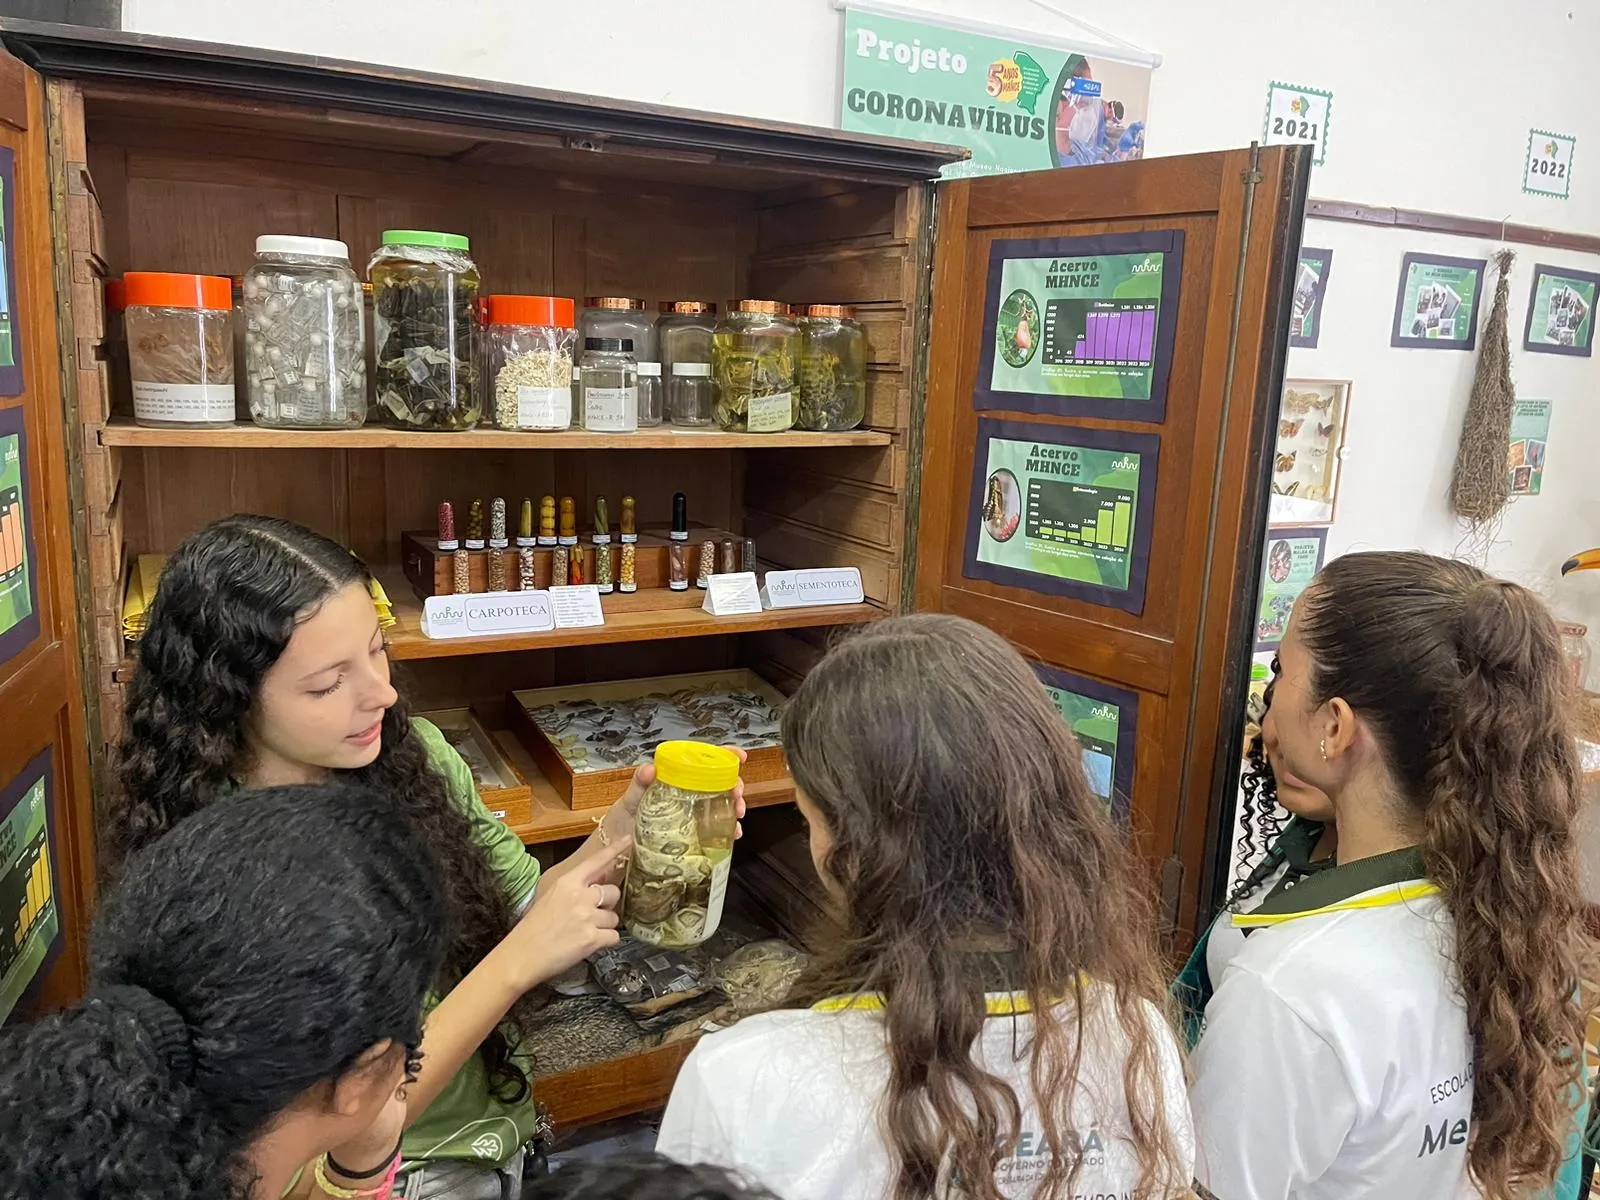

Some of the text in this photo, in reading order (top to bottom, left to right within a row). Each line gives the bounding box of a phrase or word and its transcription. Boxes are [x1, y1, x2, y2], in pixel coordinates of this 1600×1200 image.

[857, 28, 967, 75] Projeto
[985, 64, 1003, 97] 5
[847, 87, 1045, 141] CORONAVÍRUS
[1273, 117, 1318, 141] 2021
[1531, 158, 1566, 178] 2022
[1049, 260, 1098, 273] Acervo
[1045, 274, 1100, 289] MHNCE
[1030, 445, 1079, 461] Acervo
[1025, 459, 1081, 477] MHNCE
[798, 580, 858, 590] SEMENTOTECA
[468, 605, 548, 619] CARPOTECA
[1430, 1071, 1469, 1104] ESCOLA
[1417, 1117, 1468, 1158] Me
